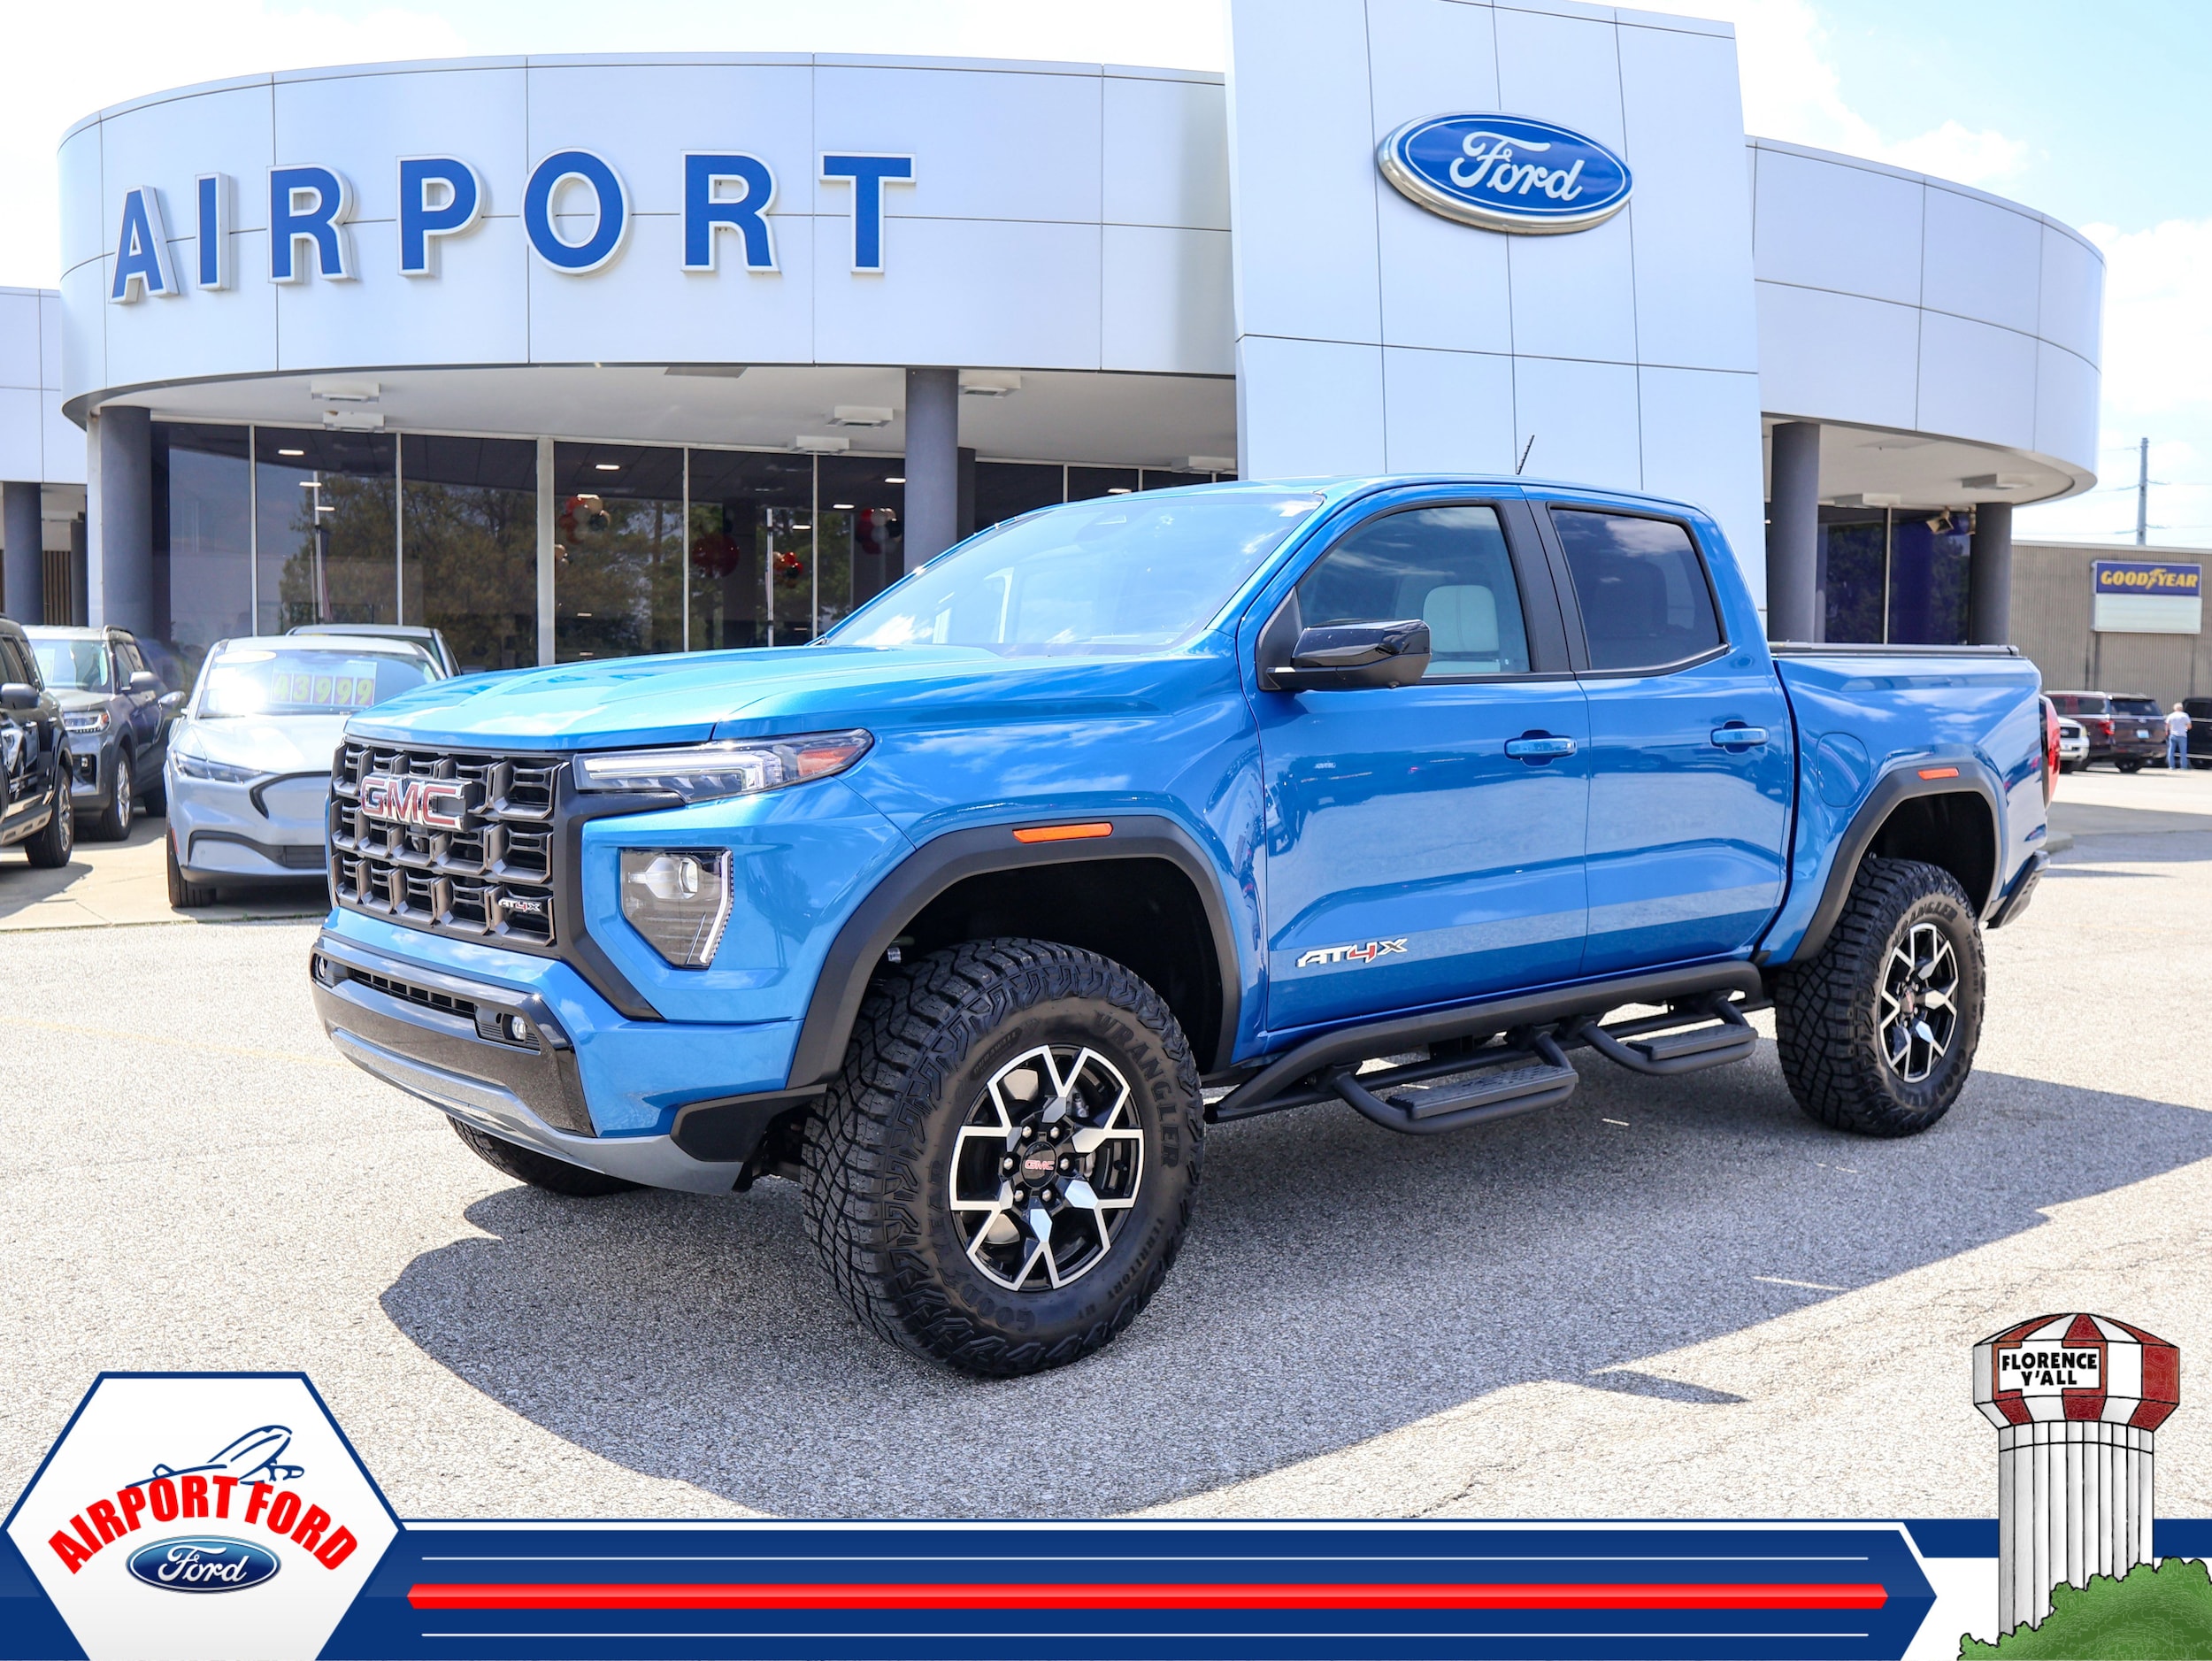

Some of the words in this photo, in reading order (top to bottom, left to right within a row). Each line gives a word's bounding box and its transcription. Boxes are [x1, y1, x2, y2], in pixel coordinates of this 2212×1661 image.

[1449, 131, 1585, 201] Ford
[109, 146, 917, 305] AIRPORT
[2101, 568, 2198, 590] GOODYEAR
[273, 673, 373, 705] 43999
[361, 775, 465, 830] GMC
[498, 897, 542, 912] AT4X
[1295, 938, 1408, 968] AT4X
[1094, 1013, 1179, 1169] WRANGLER
[1025, 1159, 1055, 1171] GMC
[929, 1159, 1036, 1332] GOODYEAR
[1109, 1217, 1164, 1299] TERRITORY
